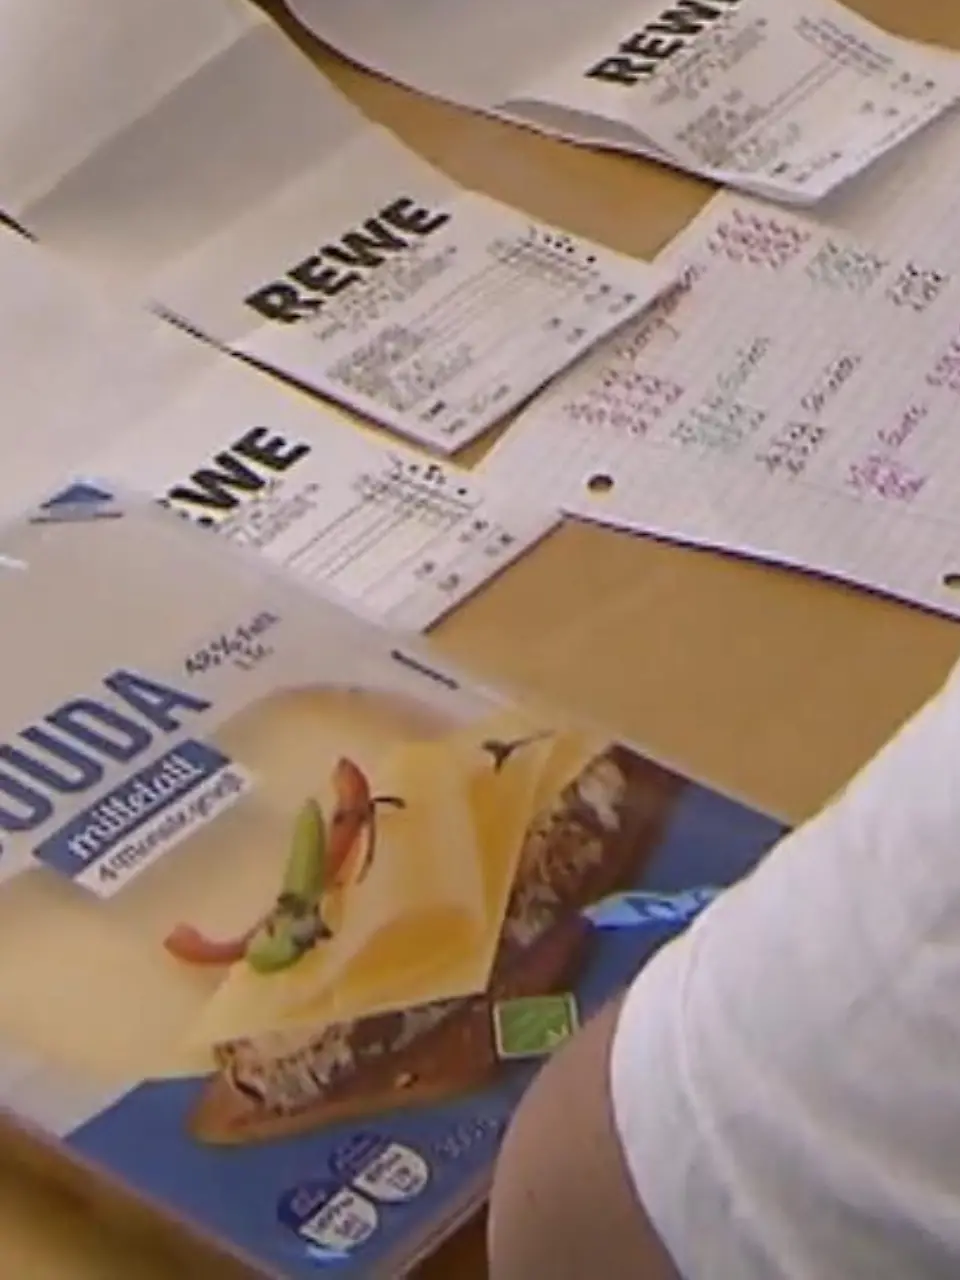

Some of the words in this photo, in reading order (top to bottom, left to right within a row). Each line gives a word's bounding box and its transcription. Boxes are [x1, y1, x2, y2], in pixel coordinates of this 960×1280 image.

[245, 196, 451, 325] REWE
[155, 425, 311, 529] WE
[0, 669, 214, 832] OUDA
